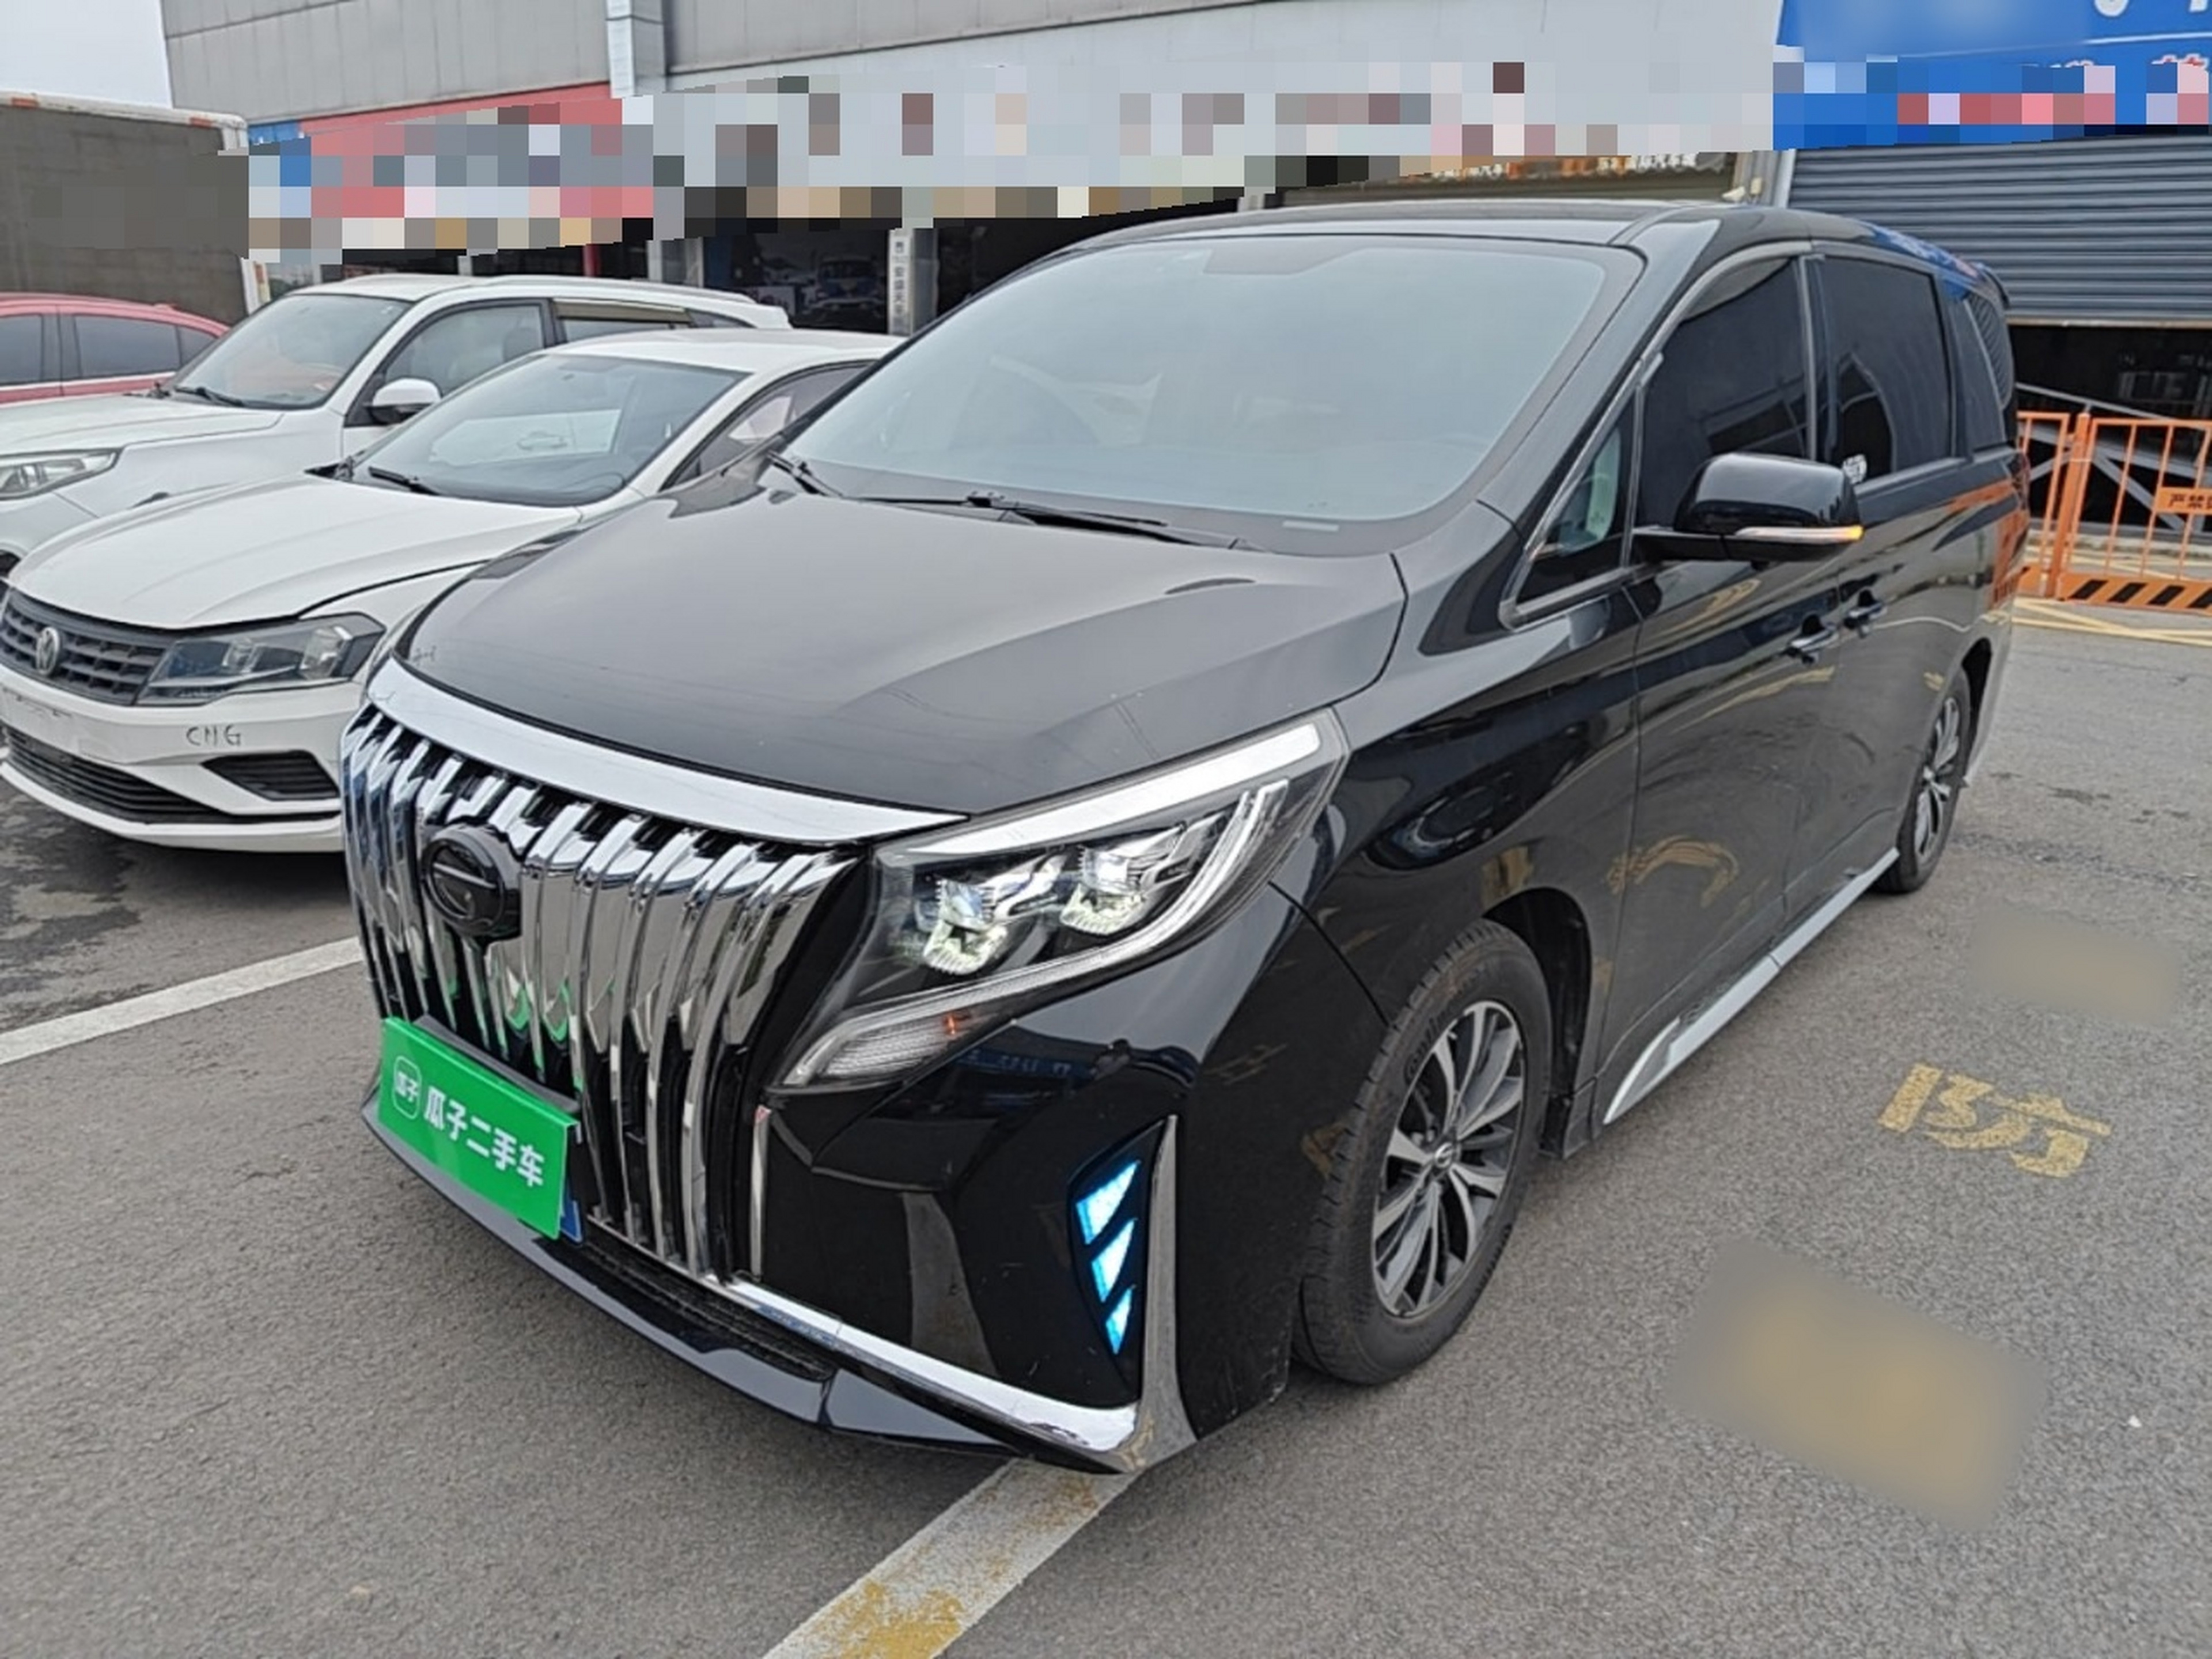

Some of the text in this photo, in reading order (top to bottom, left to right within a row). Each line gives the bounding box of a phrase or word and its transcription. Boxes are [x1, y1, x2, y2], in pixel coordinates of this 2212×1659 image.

[2168, 493, 2212, 510] 严禁
[185, 724, 241, 747] CNG
[423, 1085, 544, 1187] 瓜子二手车
[1877, 1063, 2112, 1178] 防
